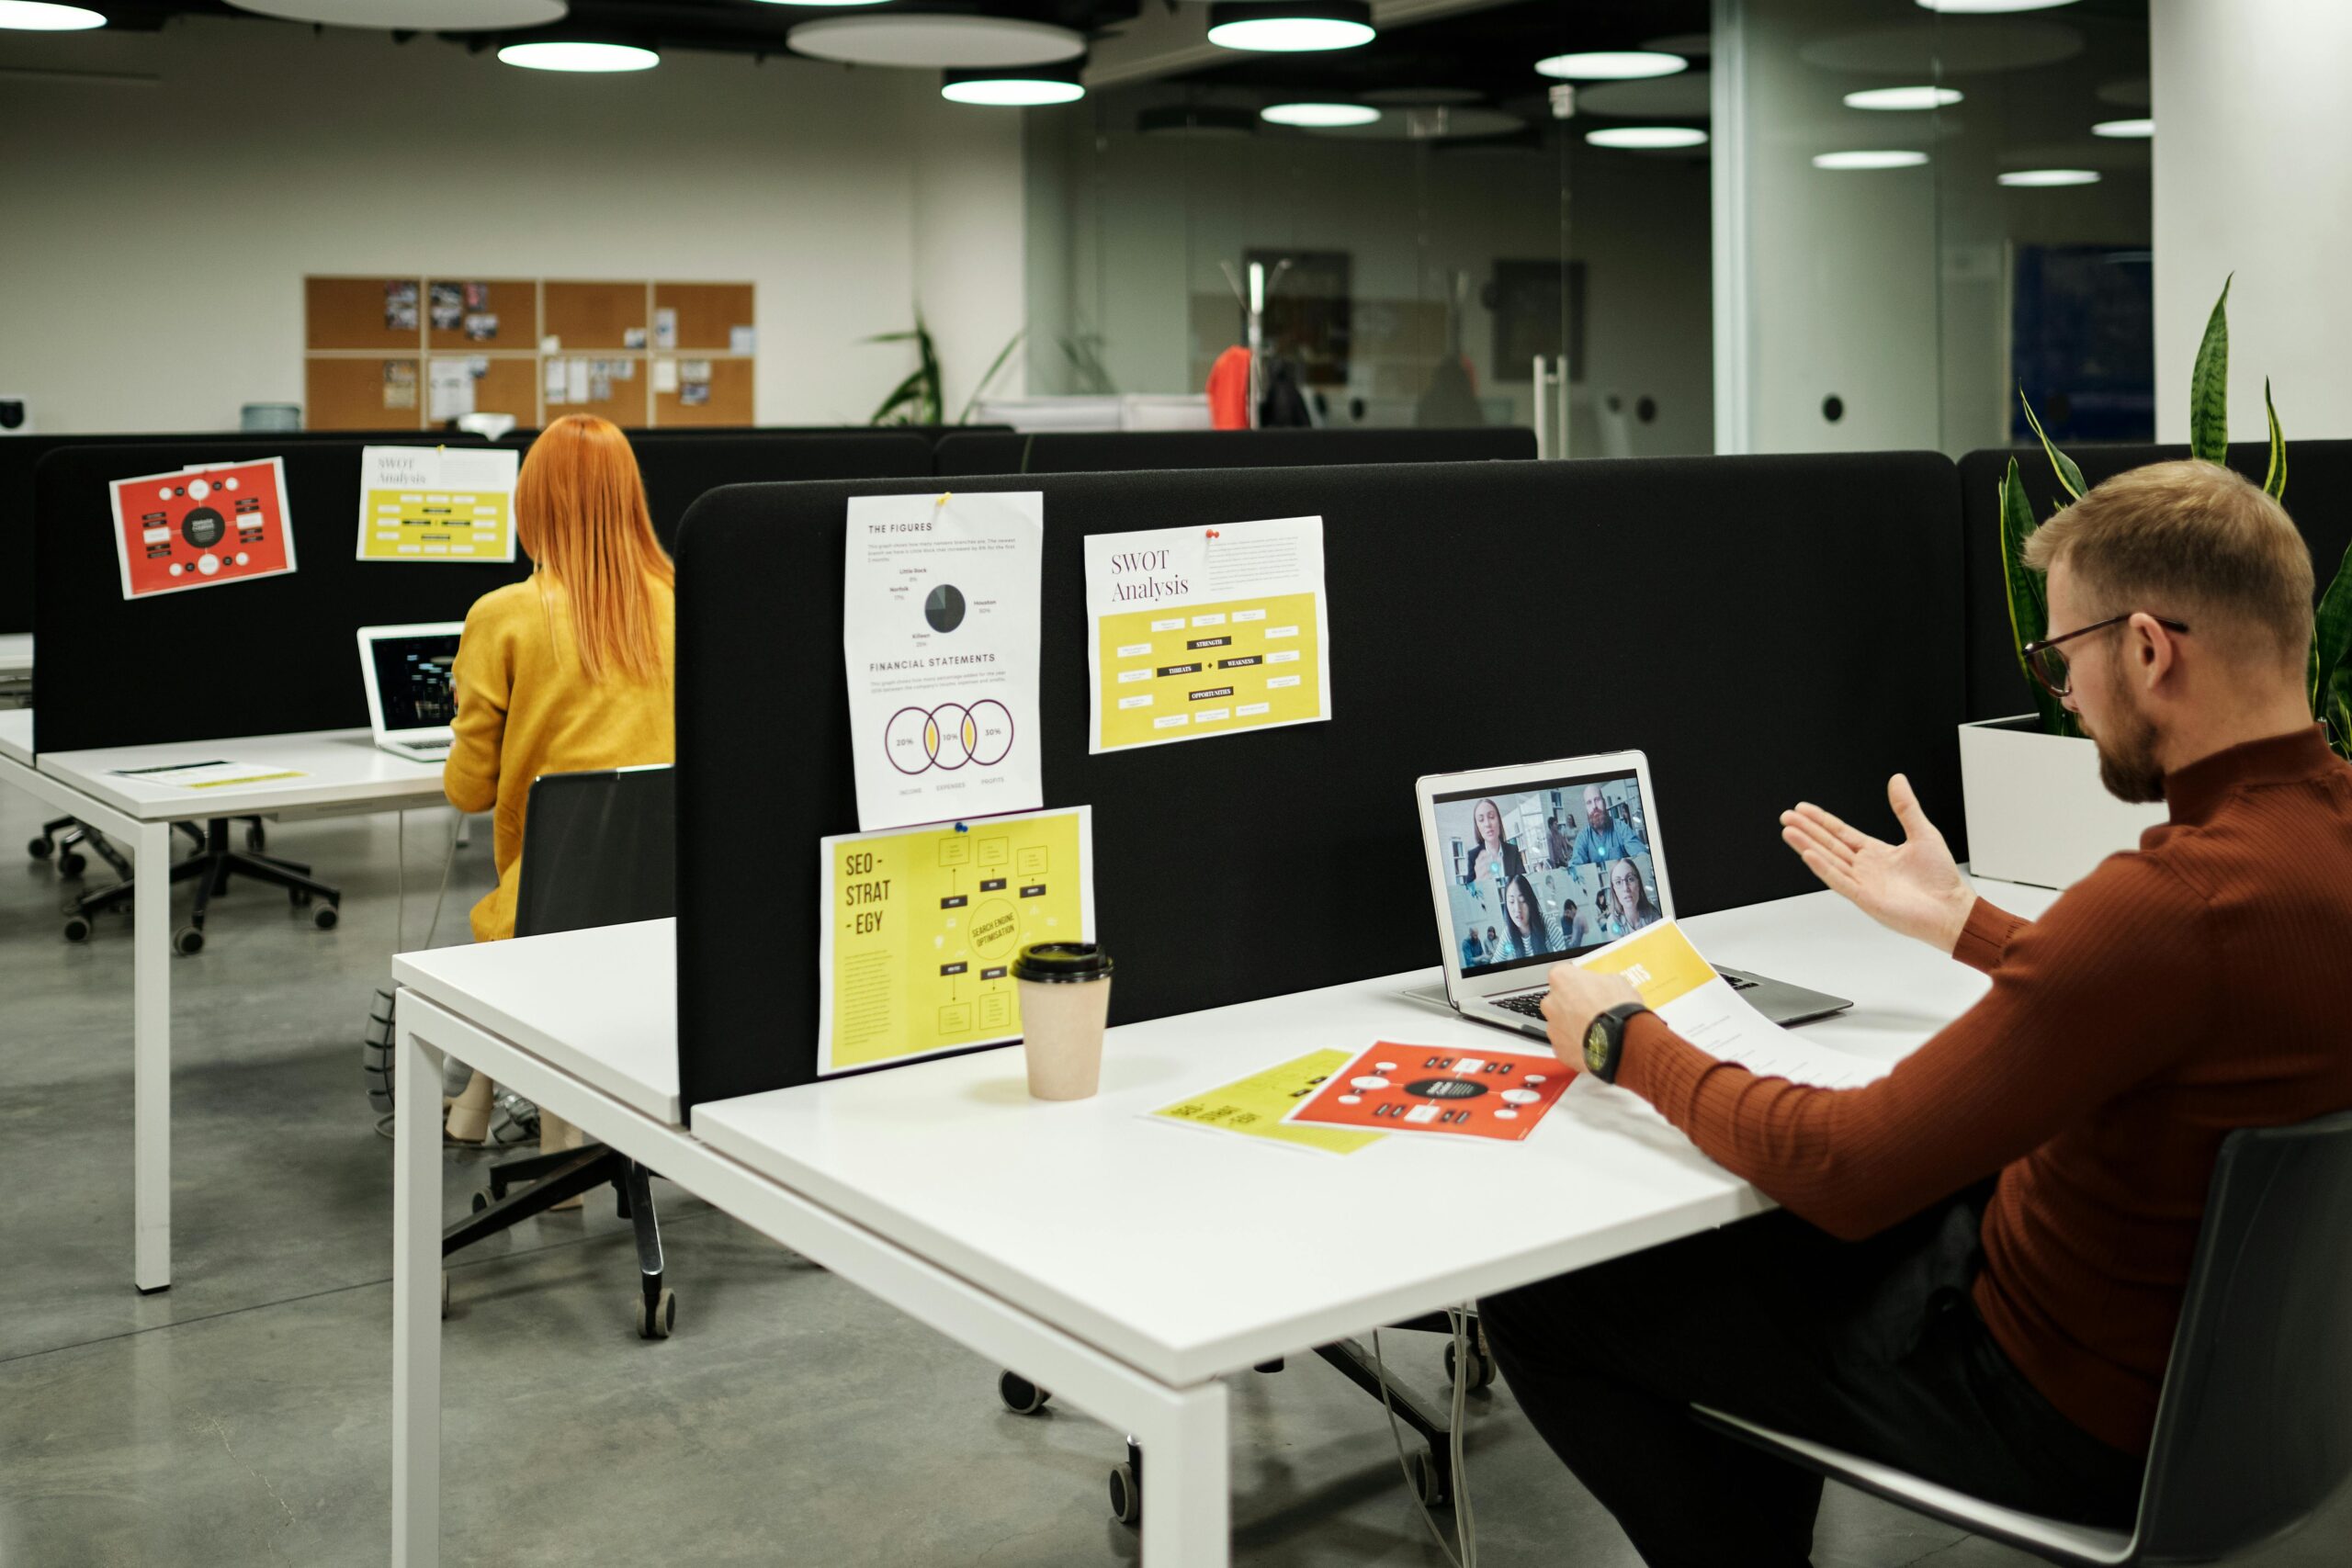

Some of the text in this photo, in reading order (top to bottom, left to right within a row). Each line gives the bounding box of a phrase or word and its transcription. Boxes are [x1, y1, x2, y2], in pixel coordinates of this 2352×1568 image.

[868, 523, 933, 534] THE FIGURES
[1112, 550, 1169, 574] SWOT
[1112, 574, 1189, 602] Analysis
[1196, 639, 1223, 648] STRENGTH
[869, 654, 995, 671] FINANCIAL STATEMENTS
[1169, 666, 1193, 674] THREATS
[1227, 659, 1255, 667] WEAKNESS
[1192, 689, 1231, 699] OPPORTUNITIES
[897, 739, 914, 747] 20%
[943, 733, 958, 741] 10%
[846, 852, 873, 875] SEO
[846, 879, 891, 906] STRAT
[856, 910, 884, 934] EGY
[972, 912, 1014, 938] SEARCH ENGINE
[977, 923, 1014, 947] OPTIMISATION
